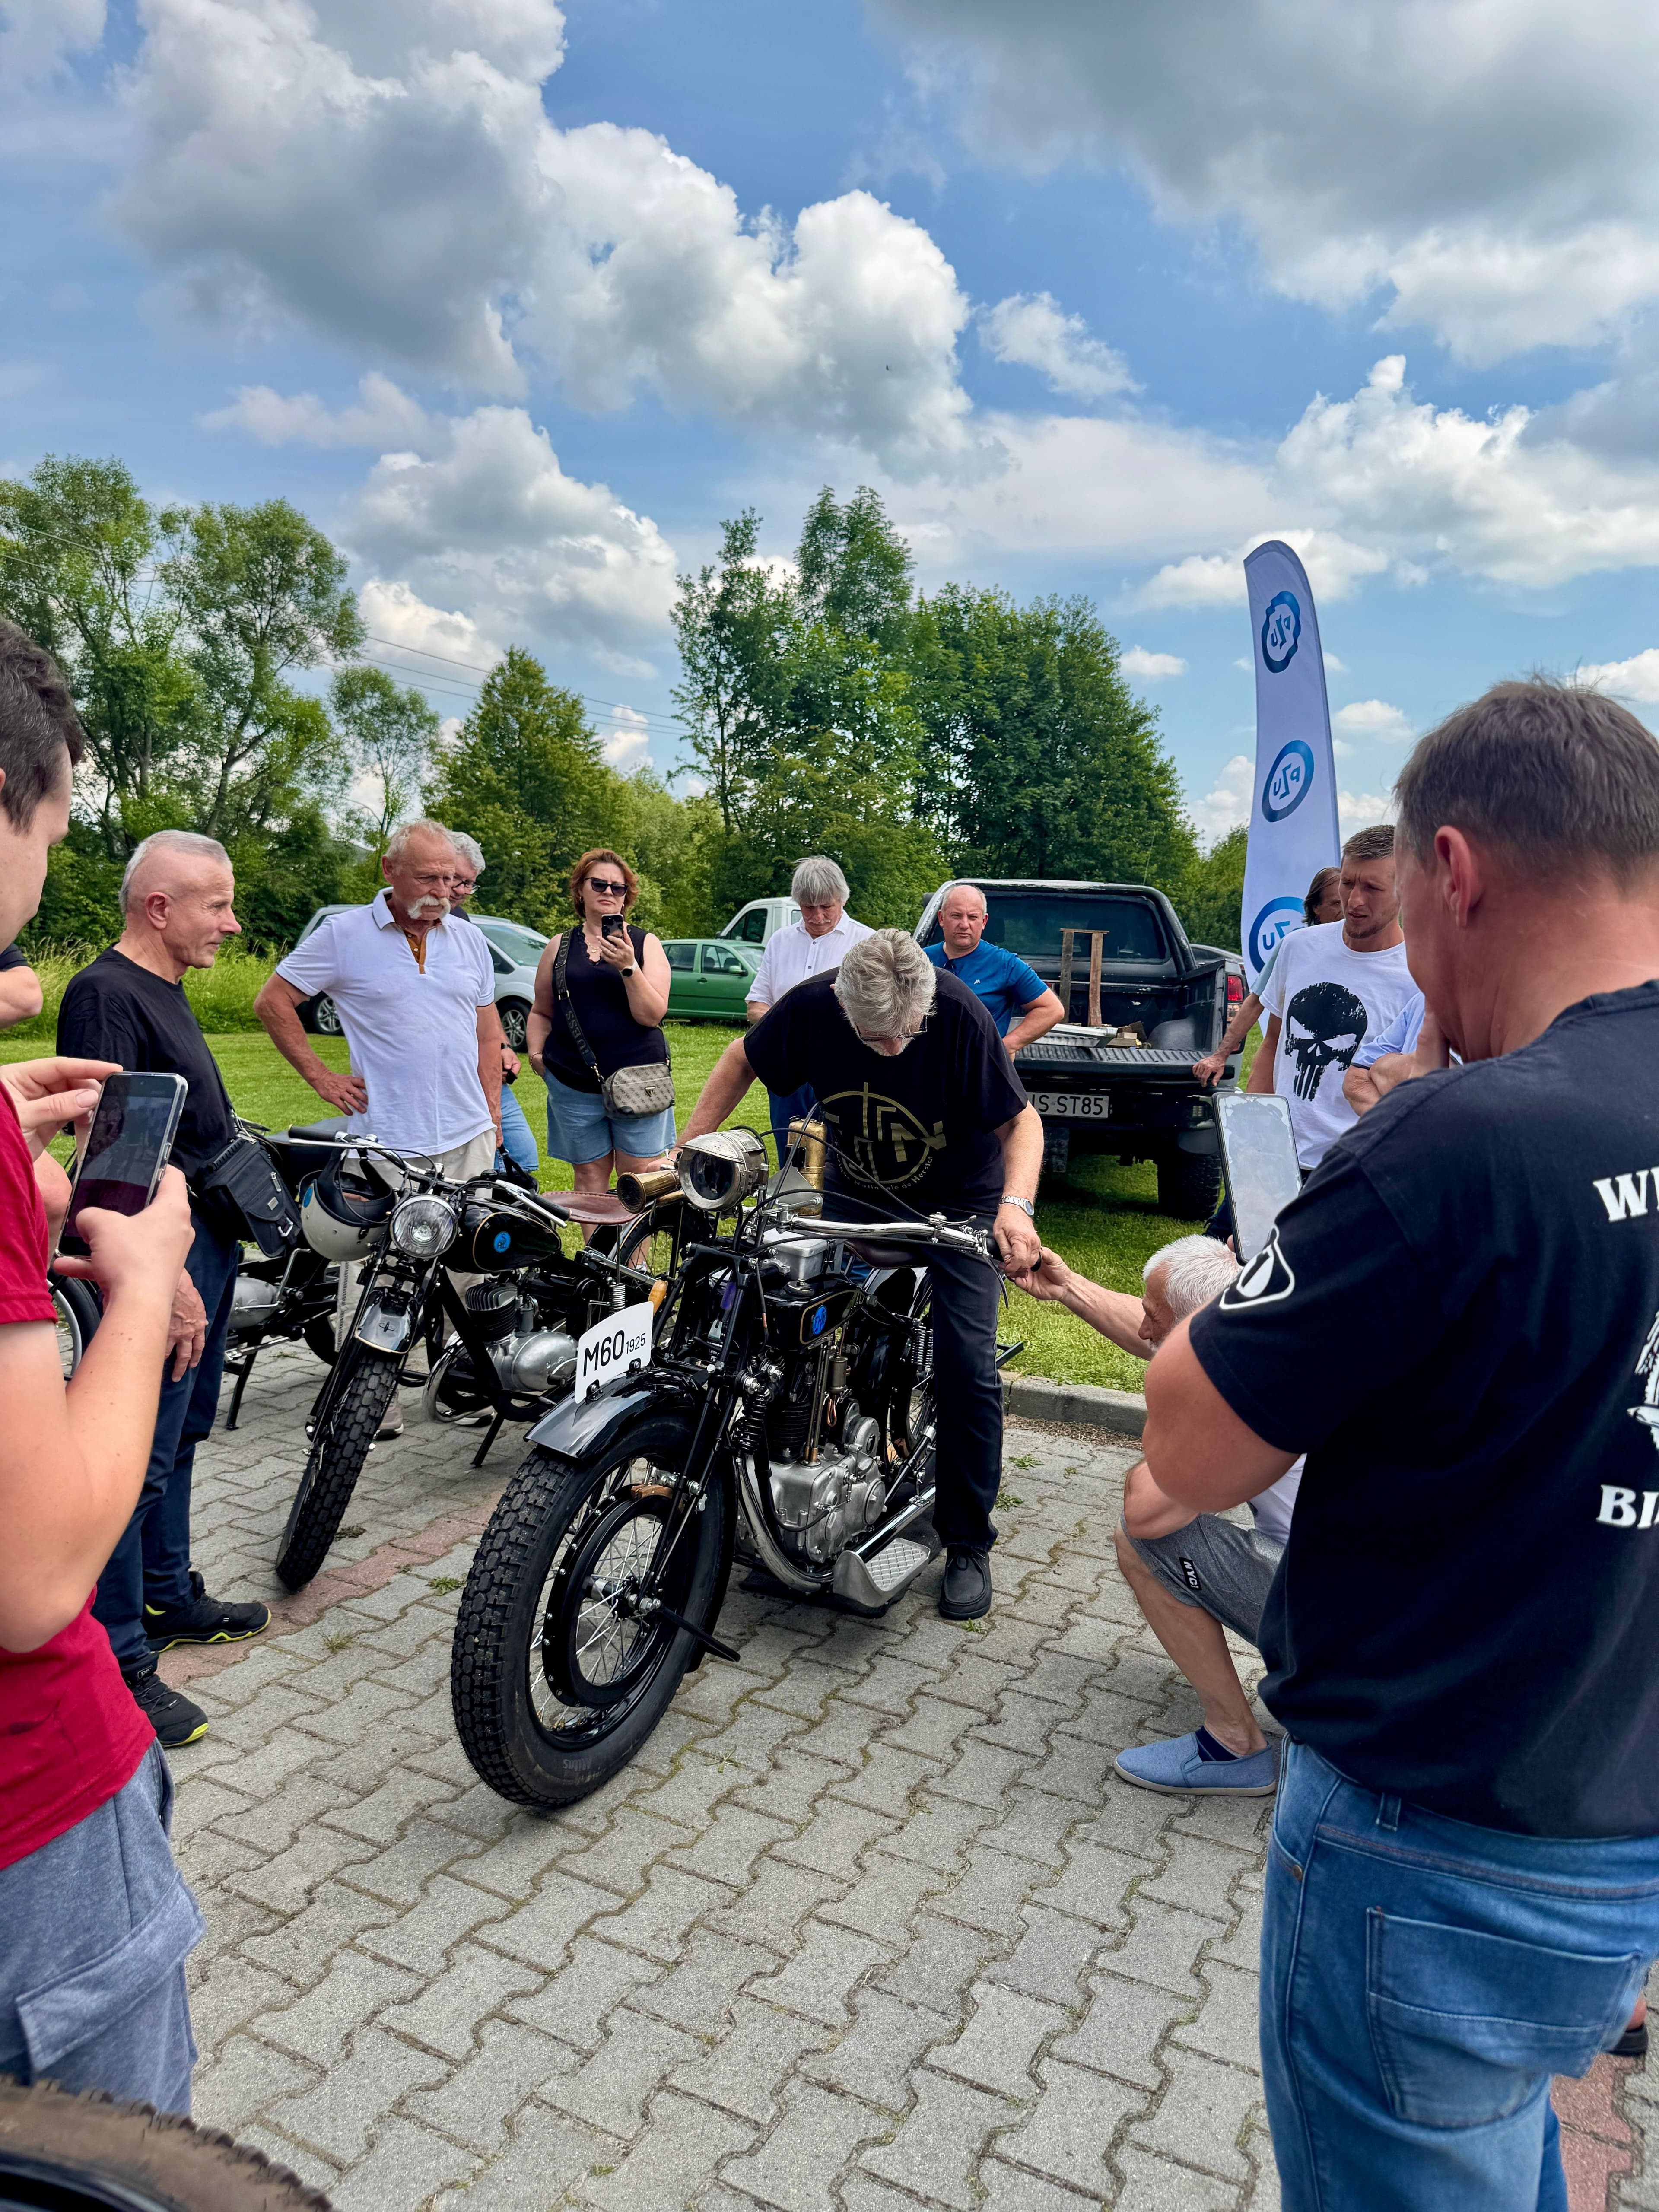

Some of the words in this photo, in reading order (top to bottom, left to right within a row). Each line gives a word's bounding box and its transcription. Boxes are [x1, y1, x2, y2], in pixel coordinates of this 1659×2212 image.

[1056, 1096, 1103, 1116] ST85
[583, 1330, 625, 1377] M60
[626, 1332, 646, 1354] 1925
[1596, 1484, 1659, 1530] BI
